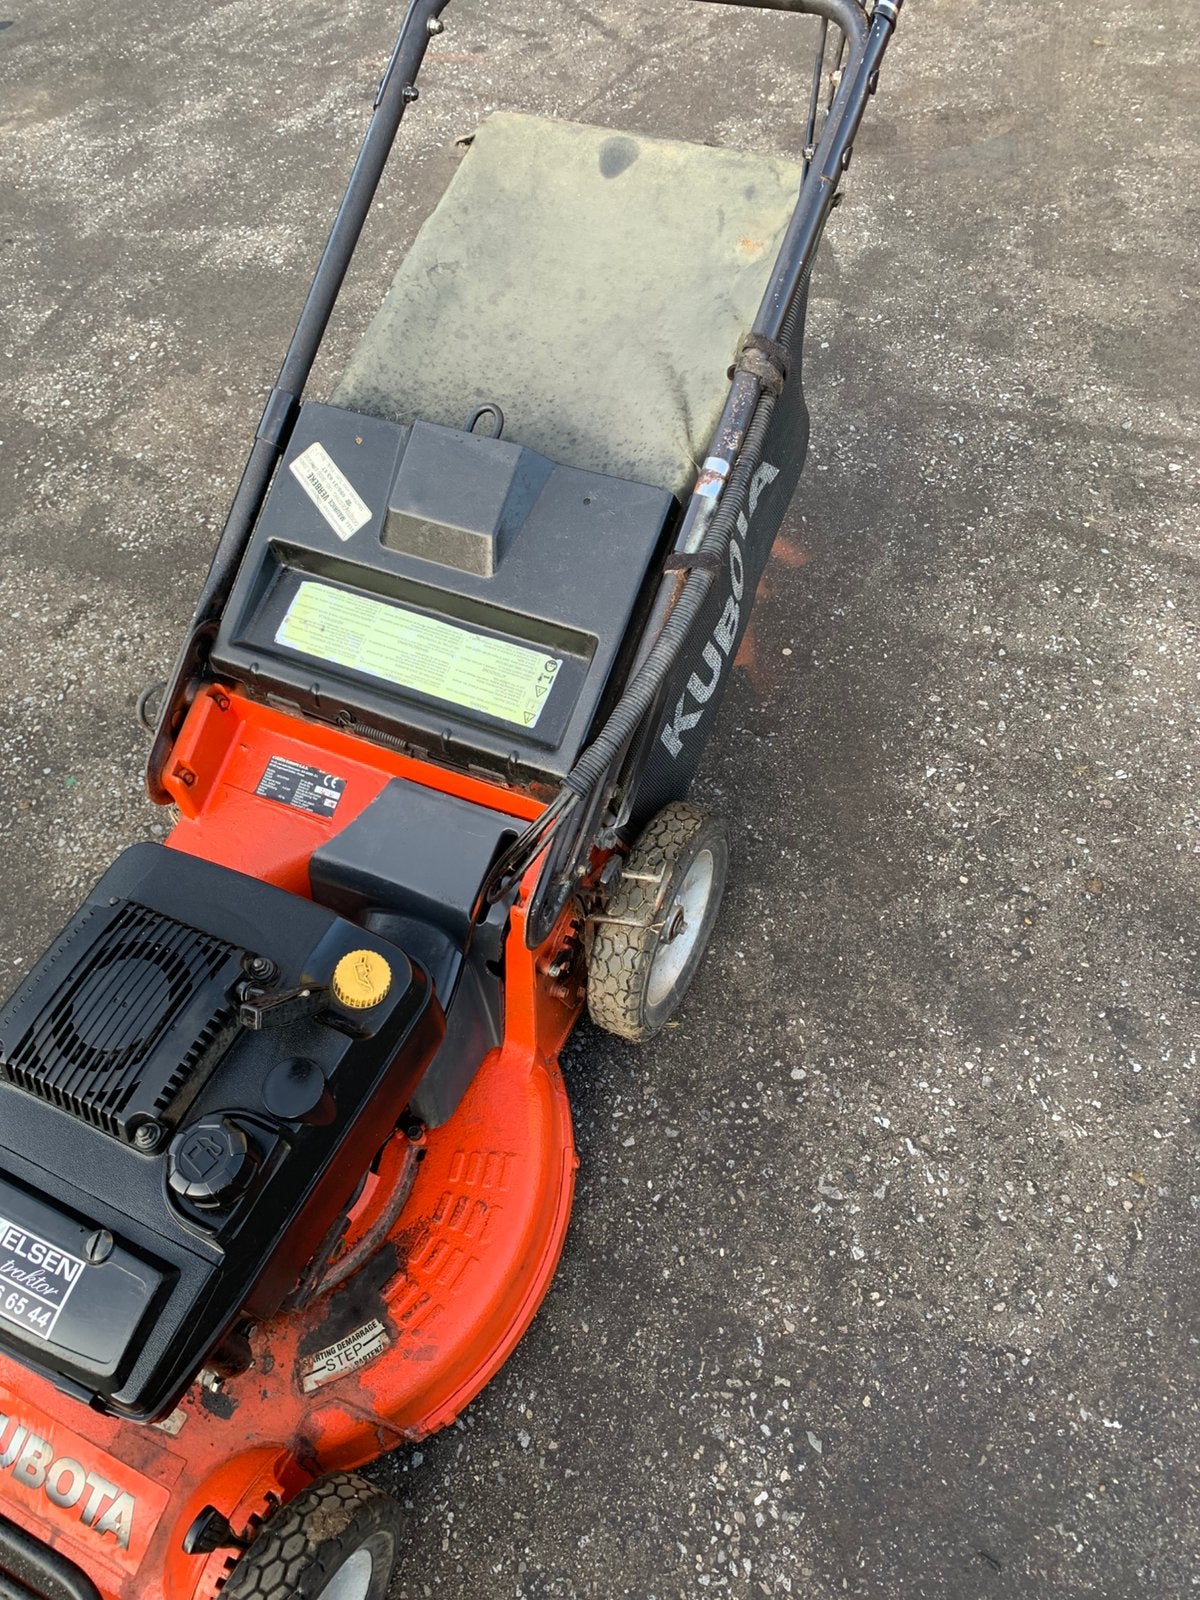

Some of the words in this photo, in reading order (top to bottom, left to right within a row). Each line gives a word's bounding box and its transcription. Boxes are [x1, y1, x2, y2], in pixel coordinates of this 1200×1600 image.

[305, 471, 330, 501] VERBEKE
[1, 1229, 79, 1282] ELSEN
[0, 1259, 59, 1295] traktor
[5, 1292, 29, 1315] 65
[27, 1306, 52, 1328] 44
[337, 1320, 378, 1351] DEMARRAGE
[325, 1342, 363, 1372] STEP
[0, 1413, 136, 1551] UBOTA
